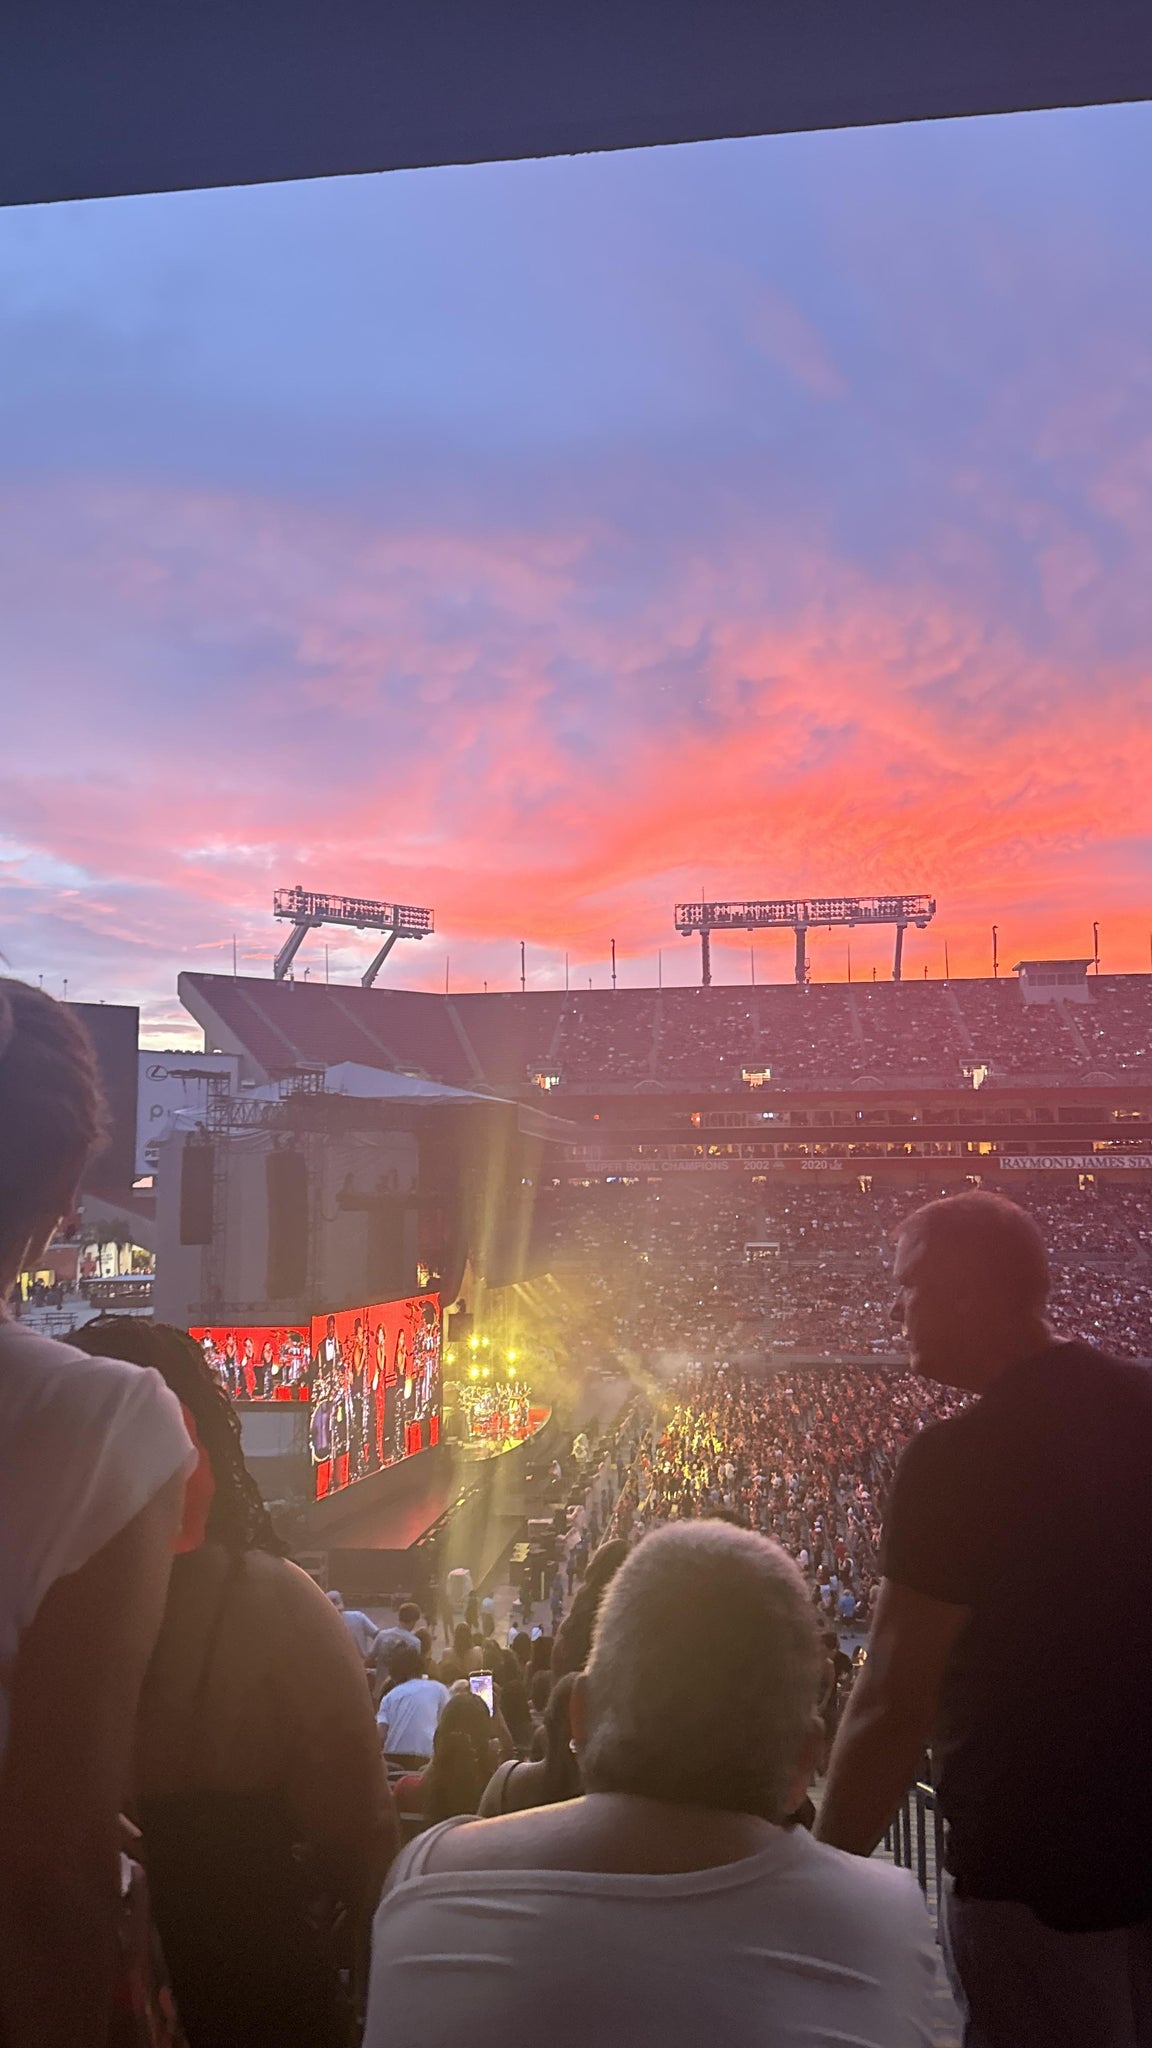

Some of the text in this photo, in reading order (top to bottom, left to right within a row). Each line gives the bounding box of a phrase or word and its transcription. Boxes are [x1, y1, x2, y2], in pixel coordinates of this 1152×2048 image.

[585, 1161, 623, 1172] SUPER
[626, 1161, 660, 1172] BOWL
[662, 1161, 729, 1171] CHAMPIONS
[743, 1161, 770, 1170] 2002
[801, 1160, 827, 1170] 2020
[1002, 1157, 1075, 1168] RAYMOND
[1077, 1157, 1125, 1168] JAMES
